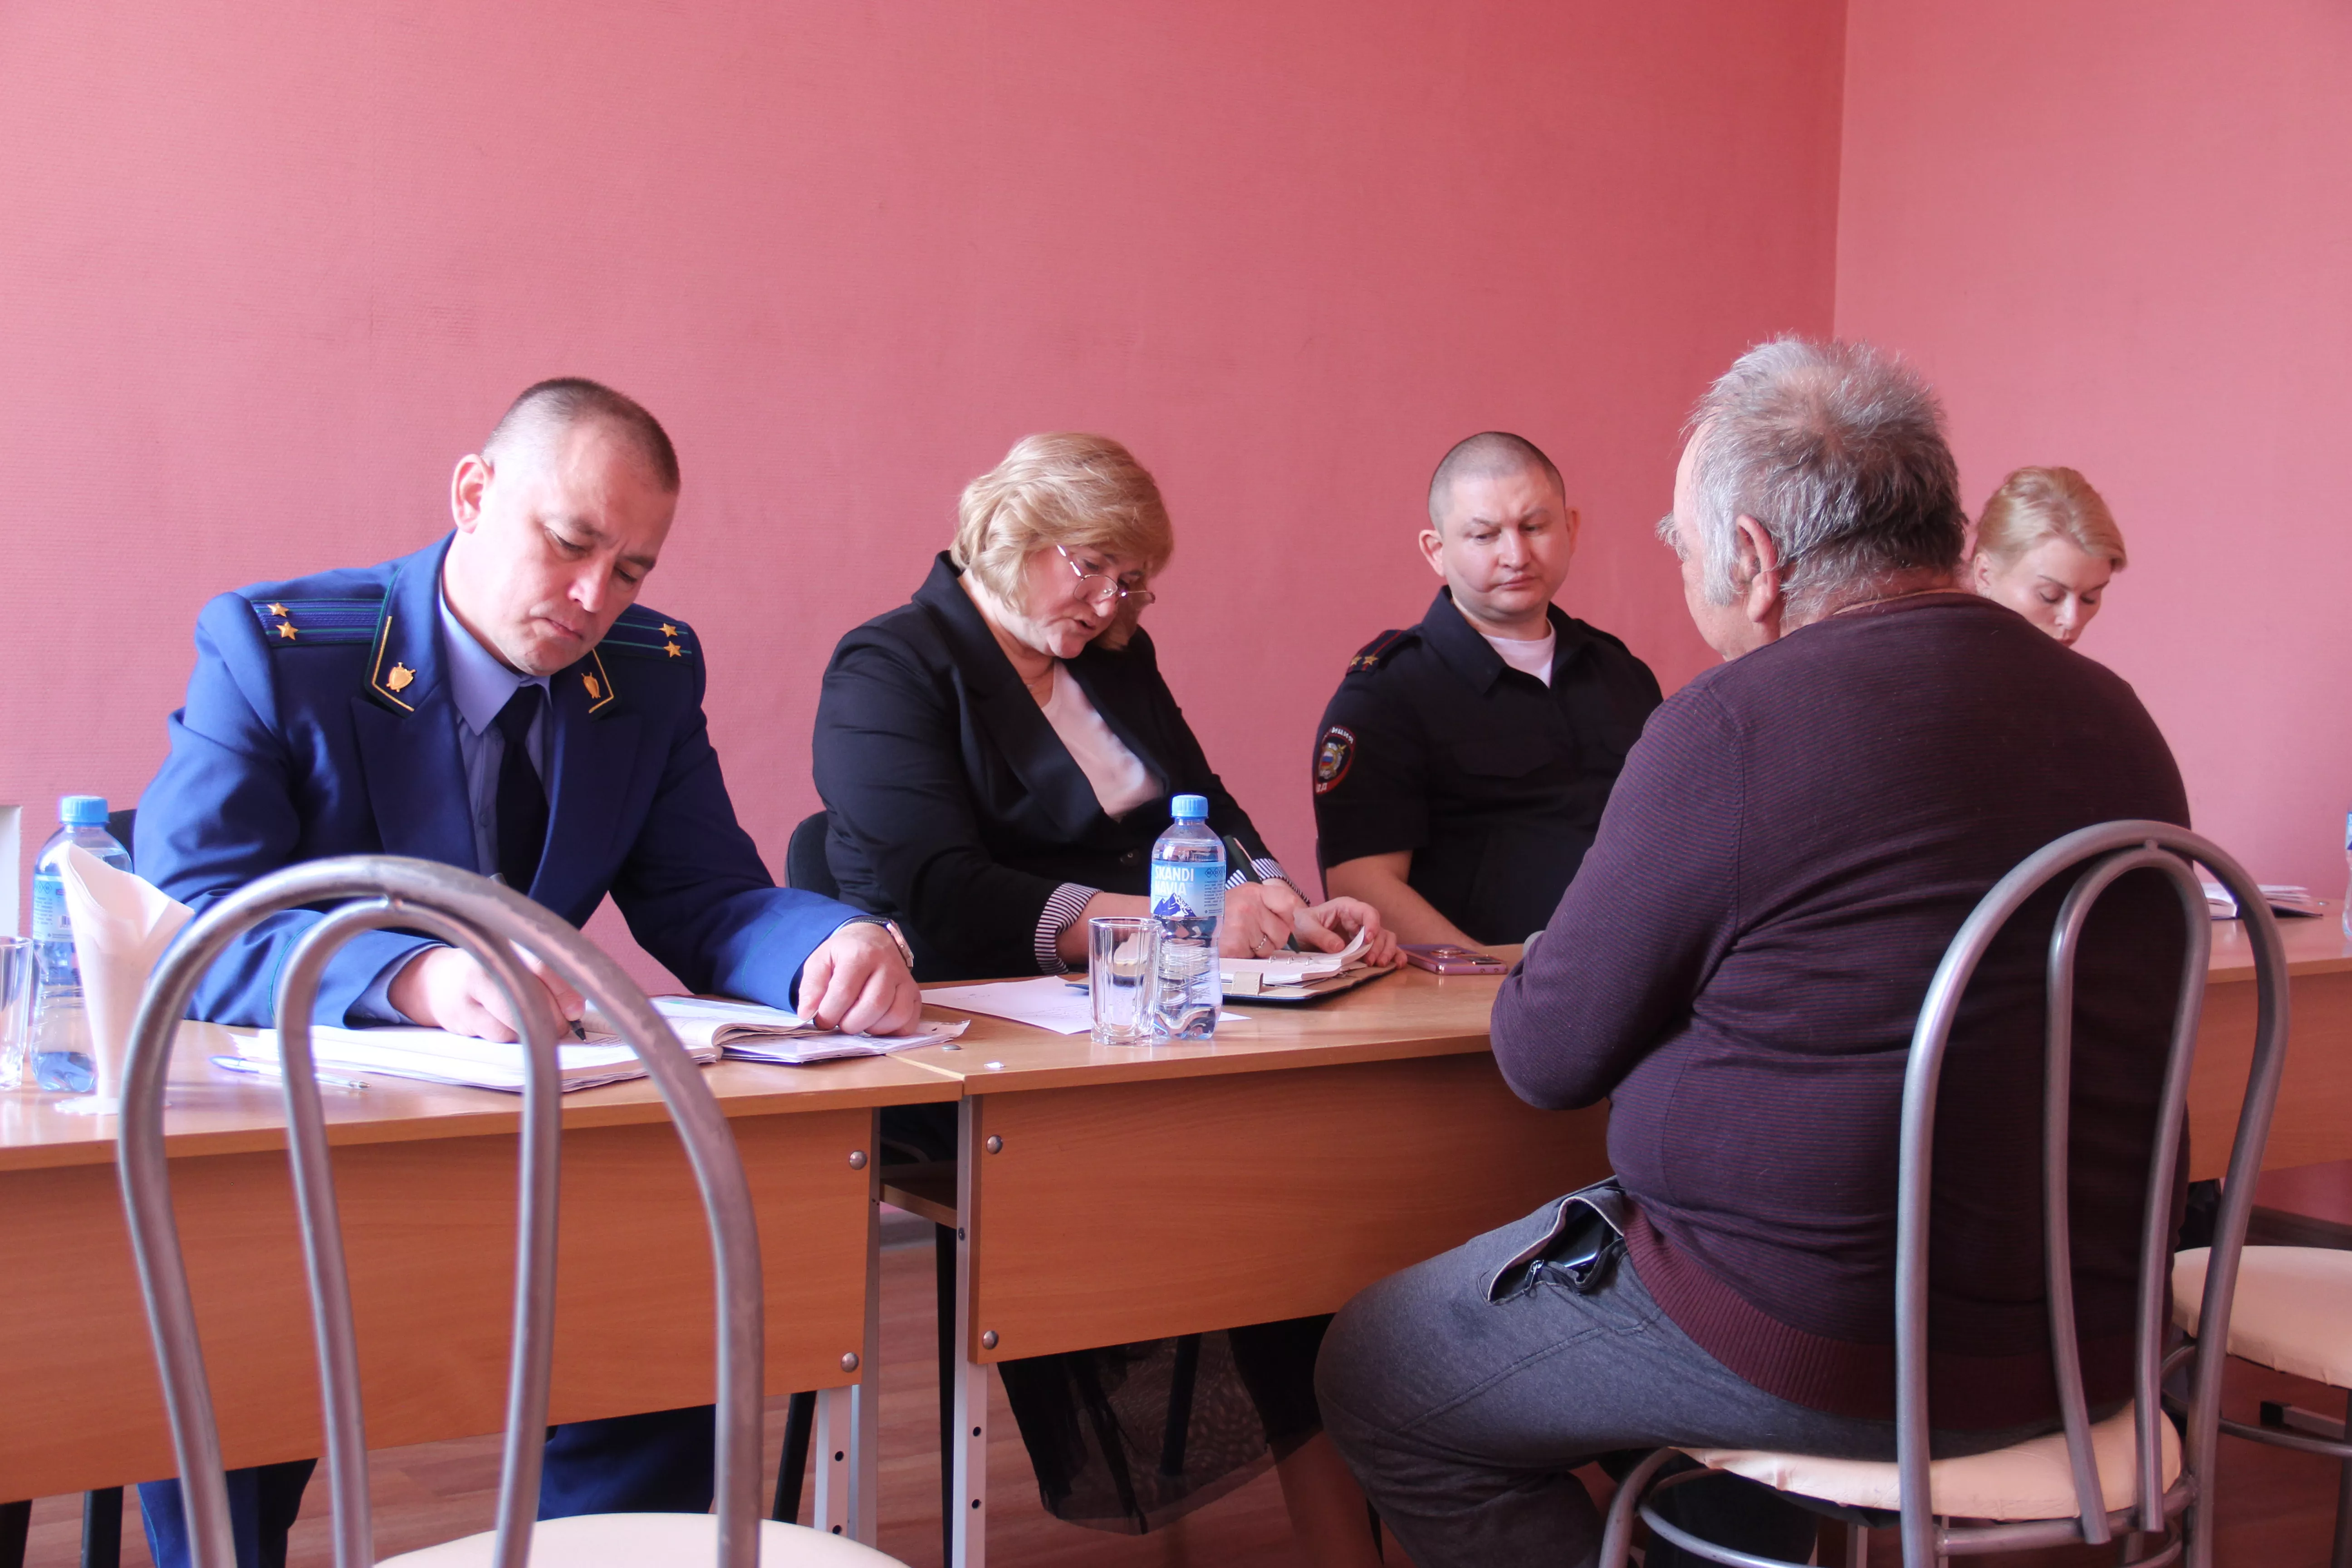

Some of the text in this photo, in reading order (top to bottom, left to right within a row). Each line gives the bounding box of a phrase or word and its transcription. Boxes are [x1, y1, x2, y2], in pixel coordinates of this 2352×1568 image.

[1322, 727, 1353, 744] ИЦИЯ
[1155, 866, 1194, 882] SKANDI
[1155, 881, 1187, 896] NAVIA
